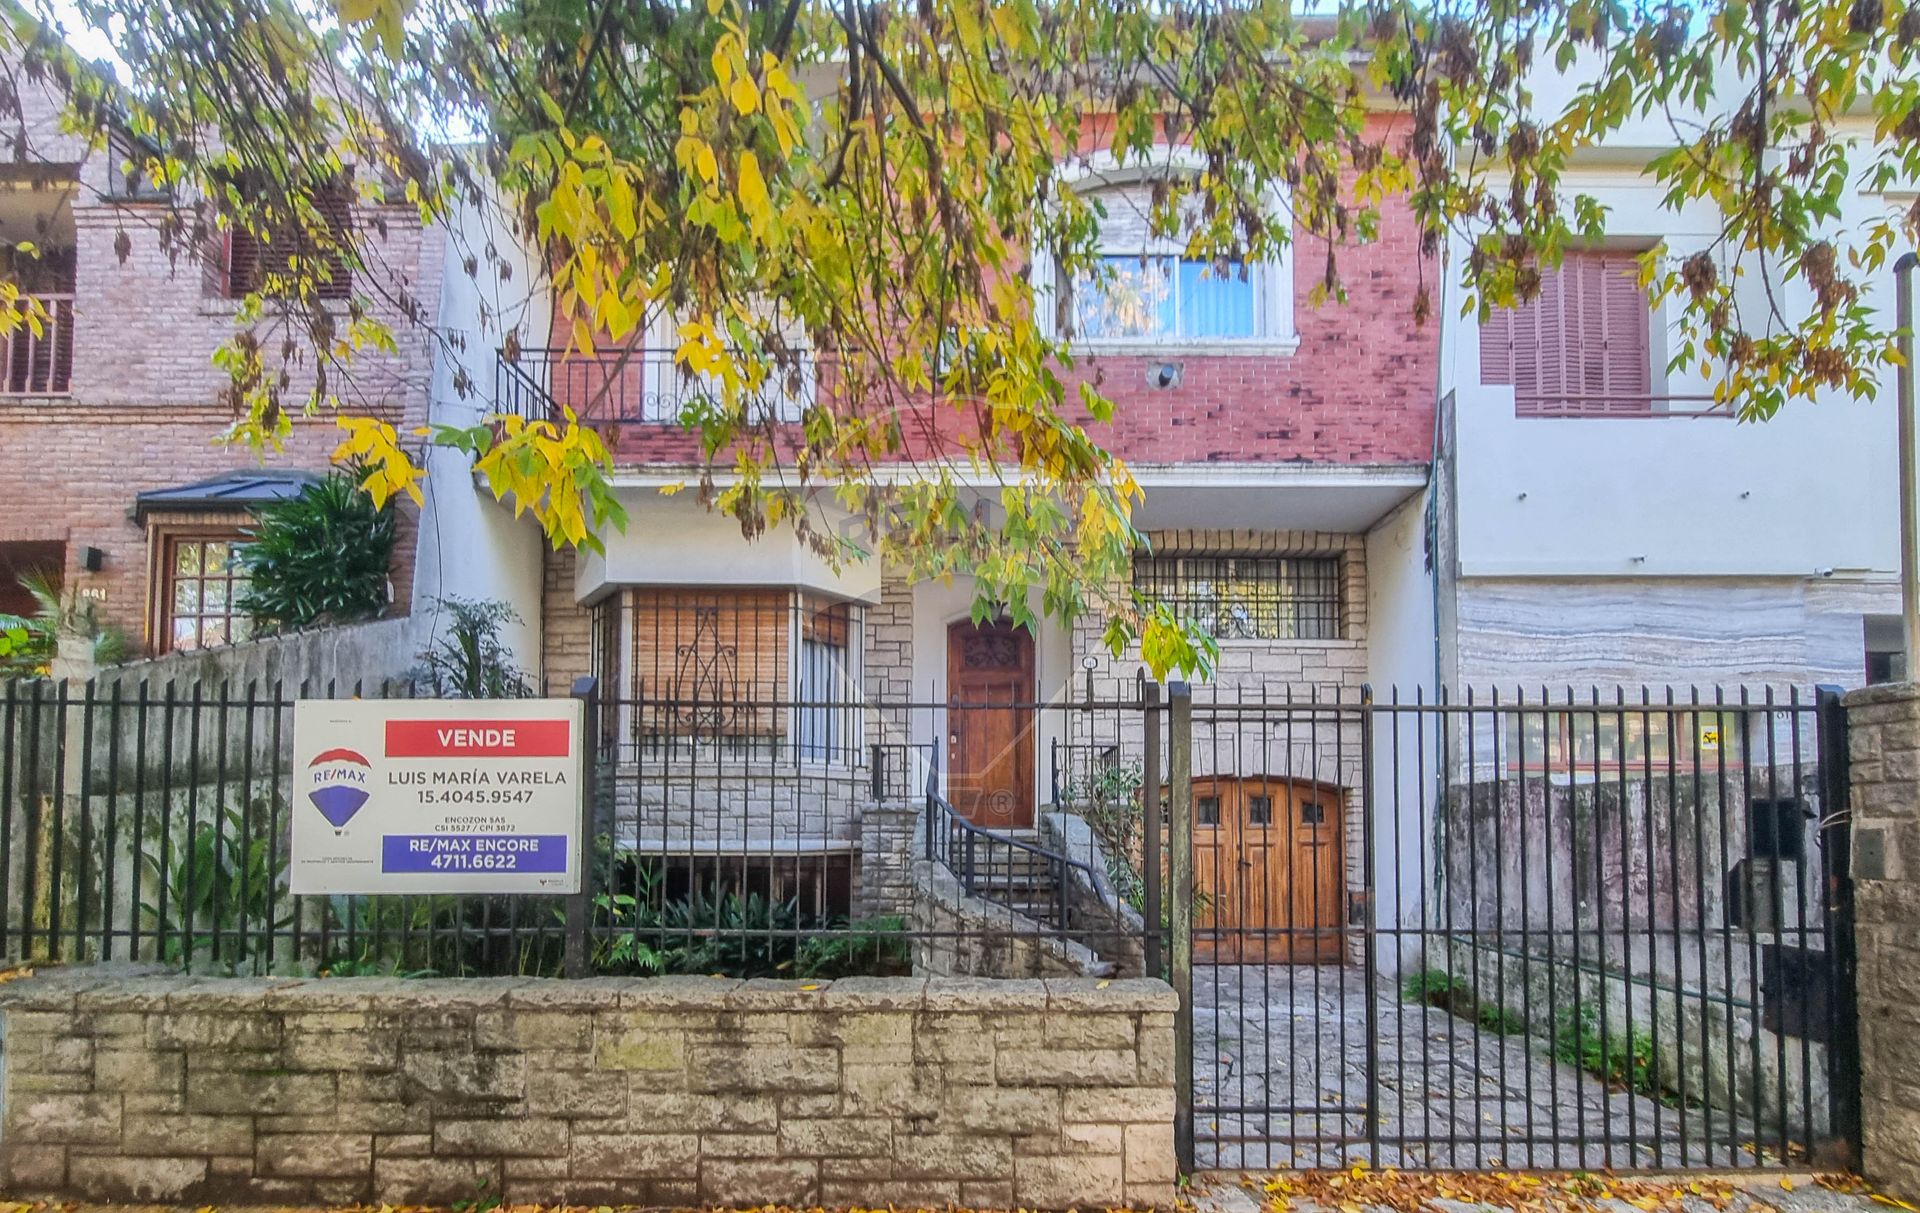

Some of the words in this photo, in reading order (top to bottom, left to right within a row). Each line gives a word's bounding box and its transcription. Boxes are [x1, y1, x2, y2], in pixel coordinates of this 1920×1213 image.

[437, 729, 516, 747] VENDE
[314, 768, 366, 783] RE/MAX
[388, 771, 426, 785] LUIS
[433, 768, 490, 785] MARÍA
[497, 771, 567, 785] VARELA
[418, 790, 534, 804] 15.4045.9547
[444, 816, 488, 824] ENCOZON
[489, 816, 506, 824] SAS
[434, 824, 449, 832] CSI
[479, 824, 494, 832] CPI
[409, 838, 471, 853] RE/MAX
[475, 839, 540, 852] ENCORE
[430, 854, 517, 869] 4711.6622
